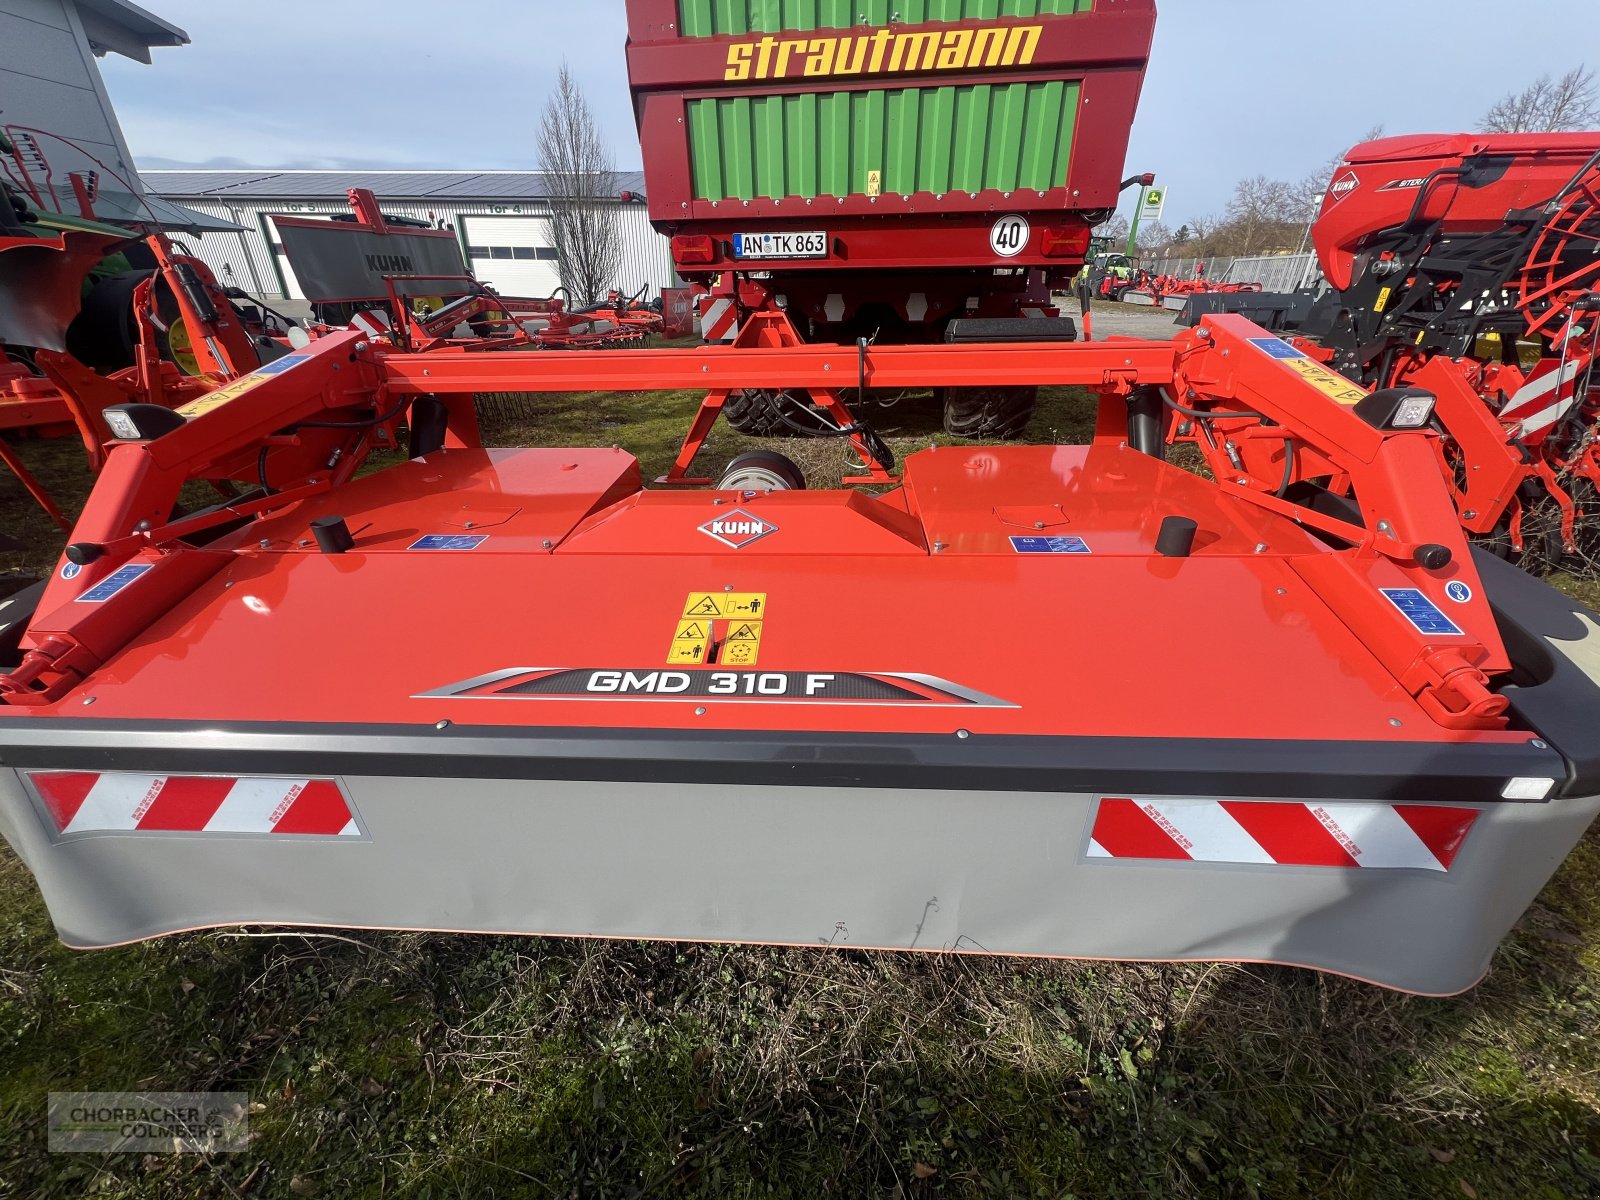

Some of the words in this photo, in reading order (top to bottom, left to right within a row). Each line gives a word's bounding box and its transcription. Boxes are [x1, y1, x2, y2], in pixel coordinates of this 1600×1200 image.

[724, 25, 1043, 80] strautmann
[1333, 180, 1356, 192] KUHN
[283, 202, 303, 211] Tor
[307, 202, 316, 211] 5
[487, 204, 508, 213] Tor
[512, 204, 521, 213] 4
[743, 236, 762, 253] AN
[773, 235, 792, 252] TK
[795, 234, 824, 252] 863
[996, 222, 1020, 248] 40
[365, 254, 414, 272] KUHN
[712, 521, 763, 534] KUHN
[586, 671, 691, 693] GMD
[708, 672, 788, 694] 310
[805, 674, 835, 695] F
